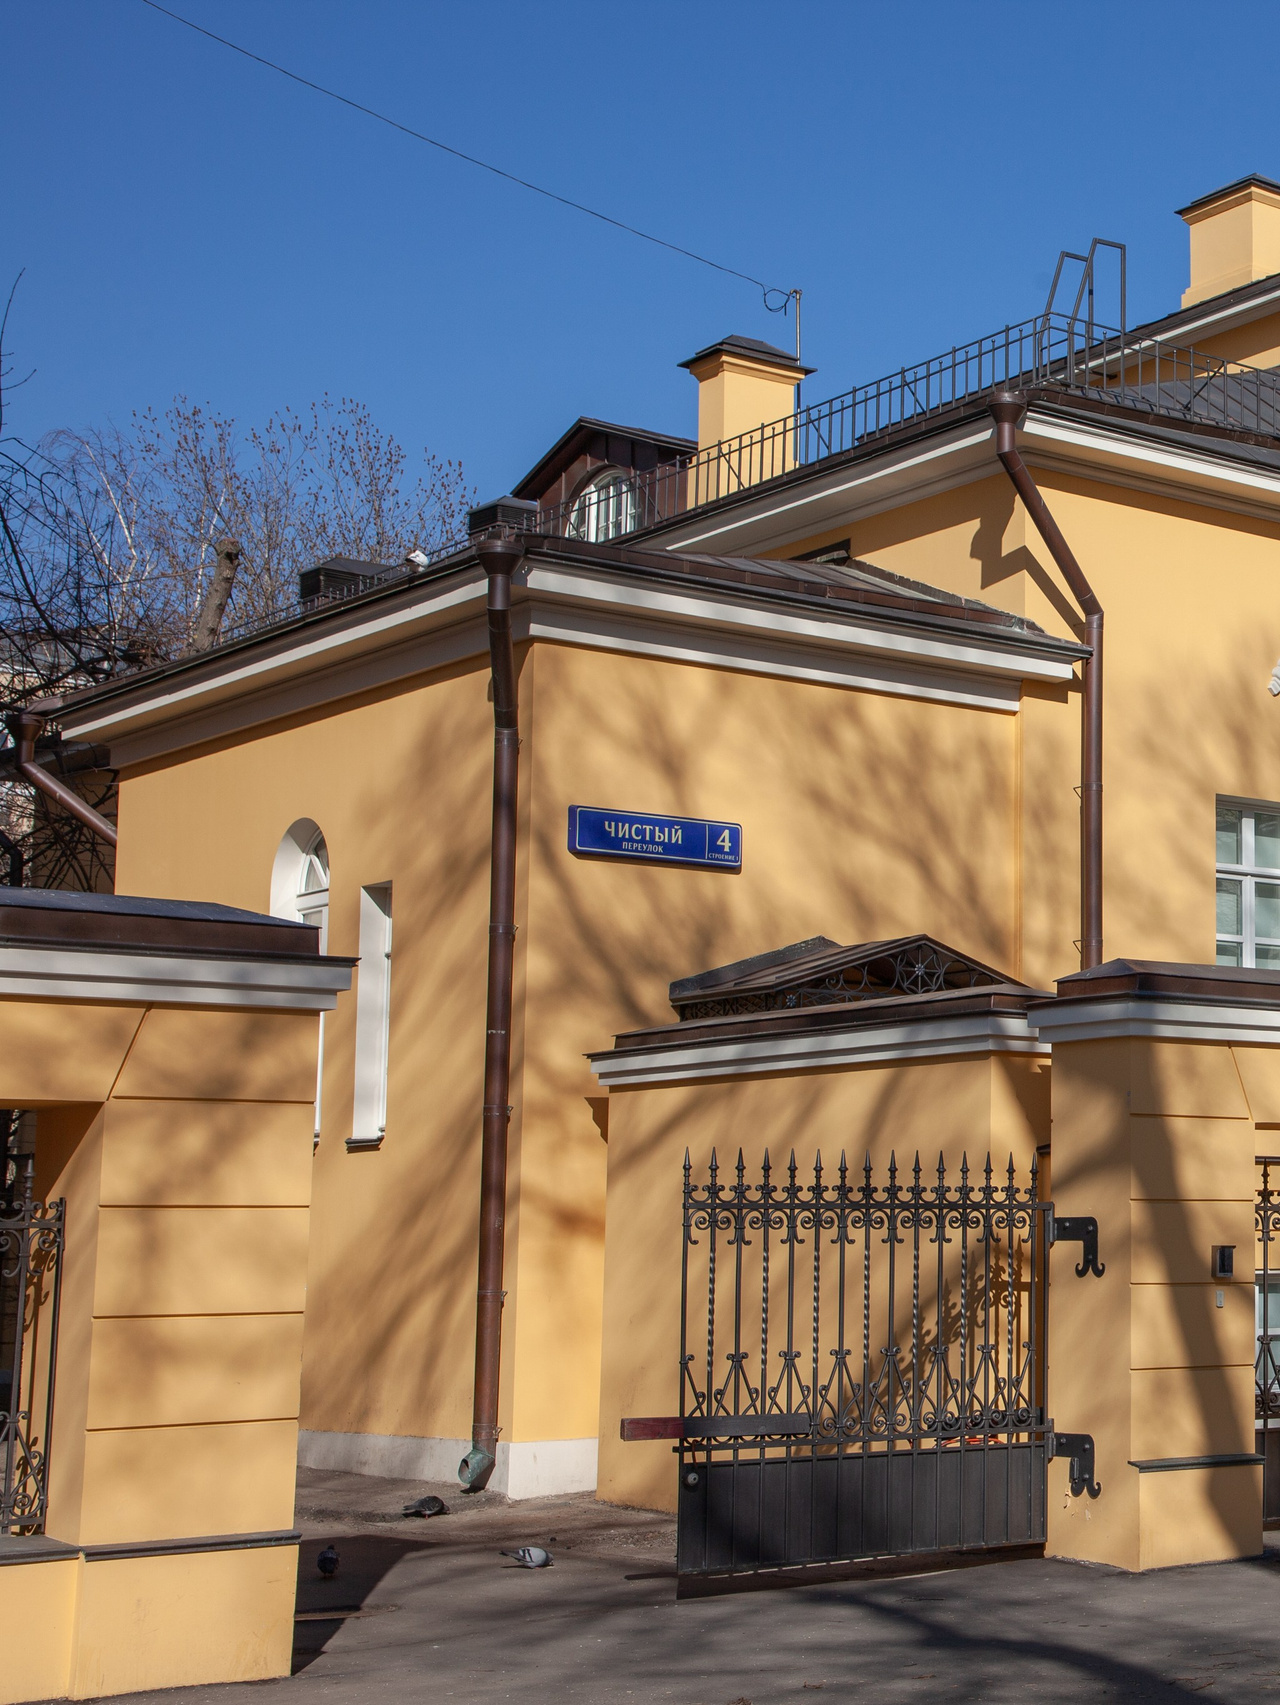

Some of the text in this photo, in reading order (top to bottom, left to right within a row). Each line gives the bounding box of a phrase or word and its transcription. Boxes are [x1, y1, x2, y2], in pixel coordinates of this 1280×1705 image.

[604, 820, 682, 844] ЧИСТЫЙ
[716, 828, 732, 852] 4
[622, 841, 664, 853] ПЕРЕУЛОК
[708, 852, 735, 861] СТРОЕНИЕ
